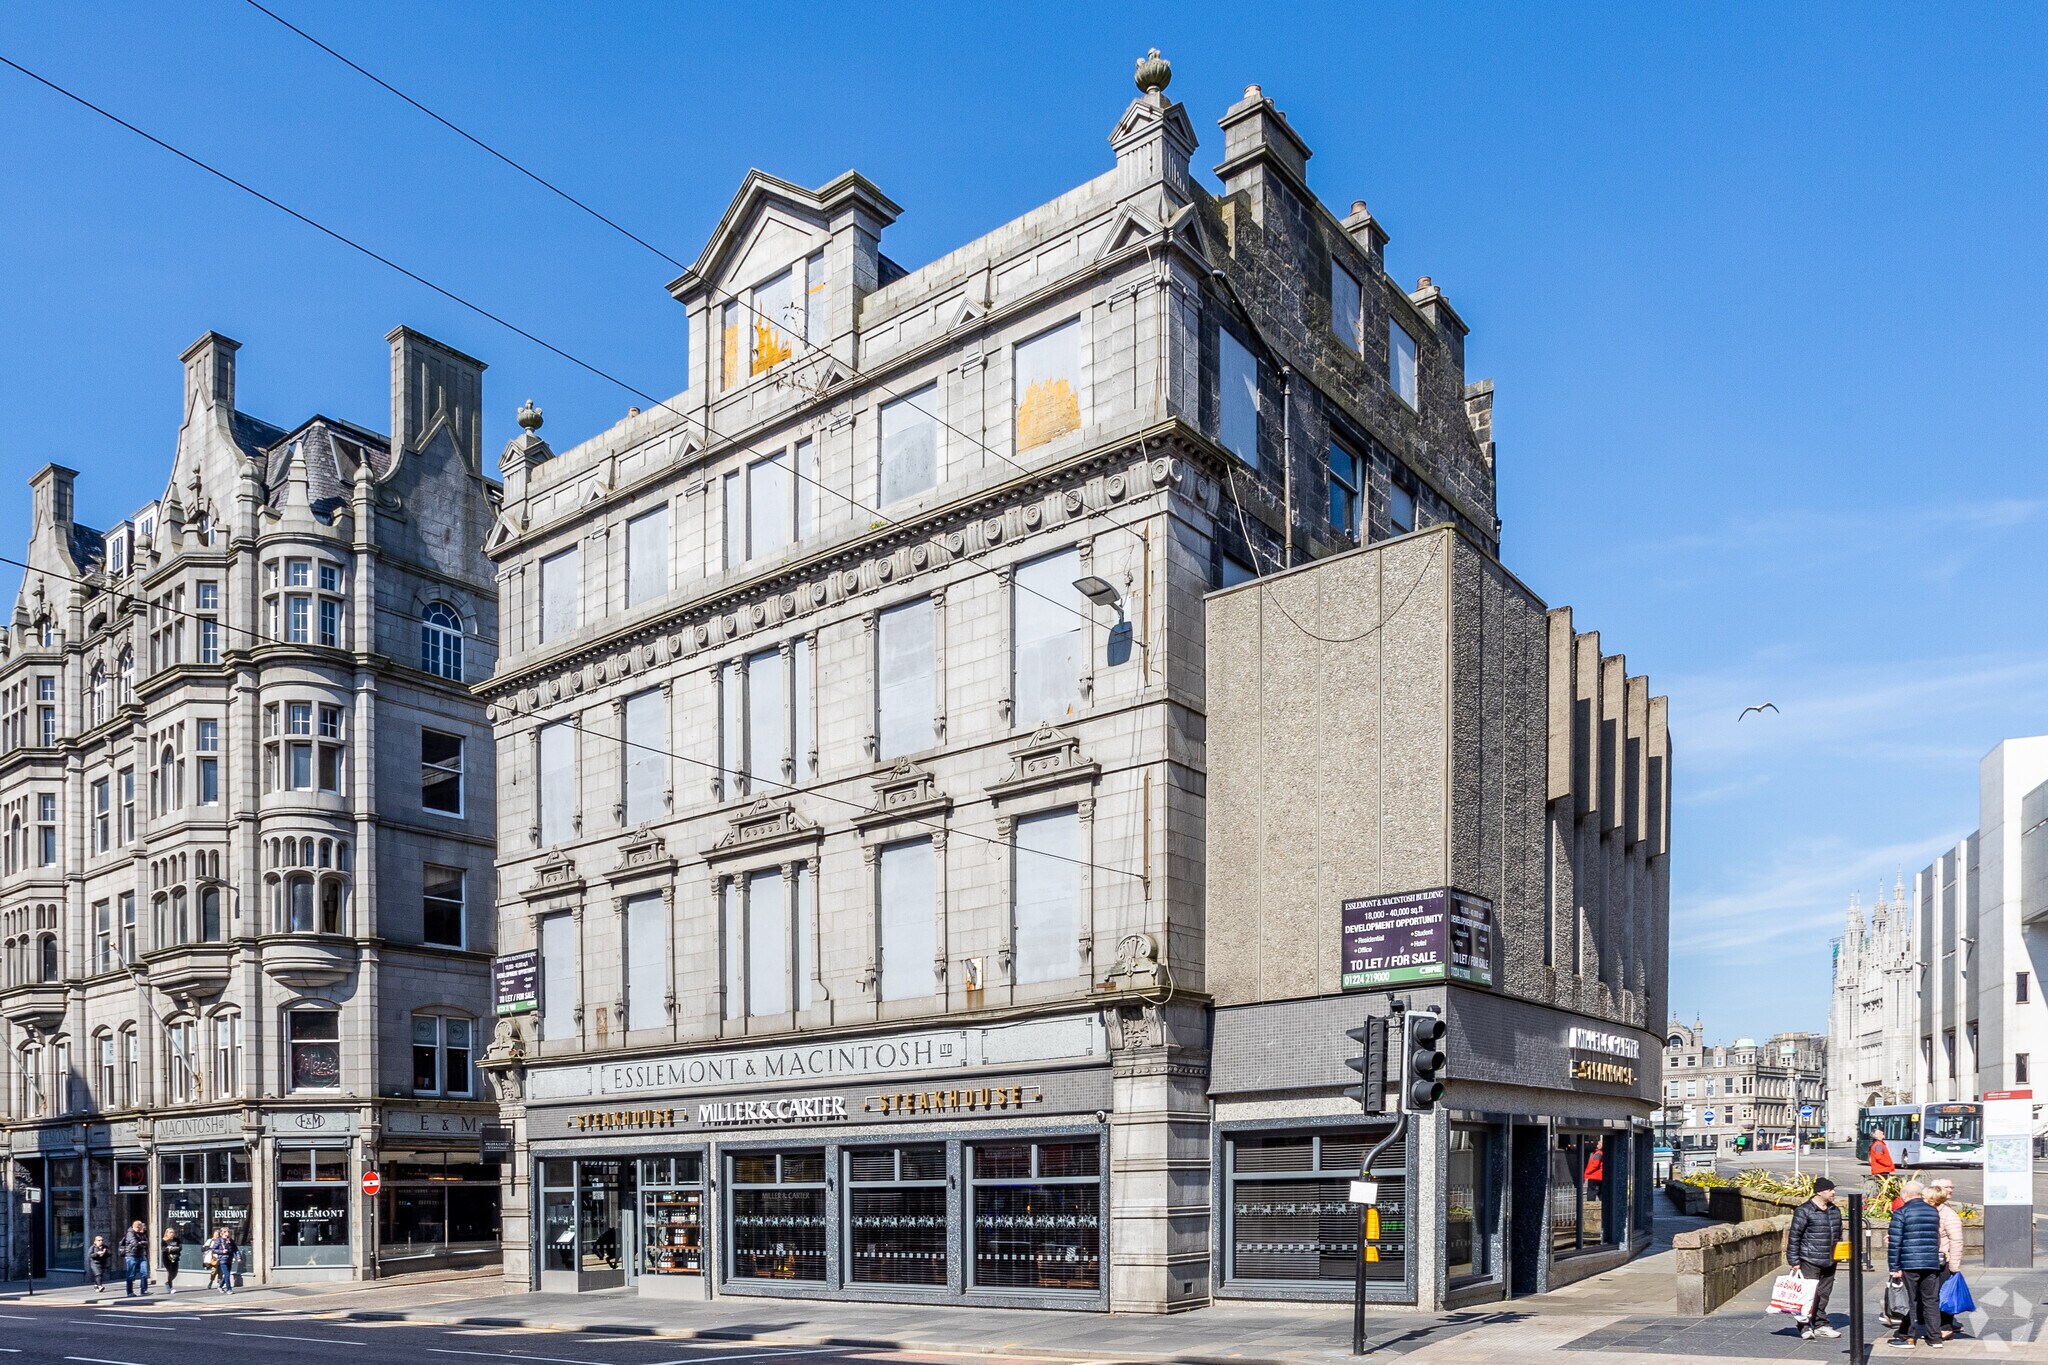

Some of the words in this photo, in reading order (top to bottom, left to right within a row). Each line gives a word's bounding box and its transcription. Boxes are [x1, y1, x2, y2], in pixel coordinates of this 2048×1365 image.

[1345, 900, 1377, 910] ESSLEMONT
[1382, 894, 1415, 905] MACINTOSH
[1416, 890, 1444, 901] BUILDING
[1365, 911, 1384, 920] 18,000
[1390, 907, 1409, 917] 40,000
[1345, 920, 1395, 933] DEVELOPMENT
[1396, 914, 1443, 927] OPPORTUNITY
[1351, 960, 1363, 971] TO
[1365, 958, 1383, 969] LET
[1384, 957, 1389, 967] /
[1392, 955, 1410, 966] FOR
[1412, 951, 1436, 964] SALE
[1420, 966, 1442, 974] CBRE
[1345, 974, 1365, 985] 01224
[1366, 972, 1390, 983] 219000
[614, 1058, 738, 1088] ESSLEMONT
[746, 1059, 757, 1076] &
[765, 1040, 932, 1078] MACINTOSH
[940, 1043, 952, 1056] LTD
[880, 1086, 1022, 1111] STEAKHOUSE
[576, 1108, 674, 1128] STEAKHOUSE
[698, 1102, 760, 1122] MILLER
[776, 1096, 847, 1118] CARTER
[160, 1116, 218, 1135] MACINTOSH
[420, 1115, 429, 1130] E
[442, 1116, 450, 1131] &
[461, 1117, 476, 1132] M
[168, 1210, 199, 1218] ESSLEMONT
[214, 1210, 247, 1218] ESSLEMONT
